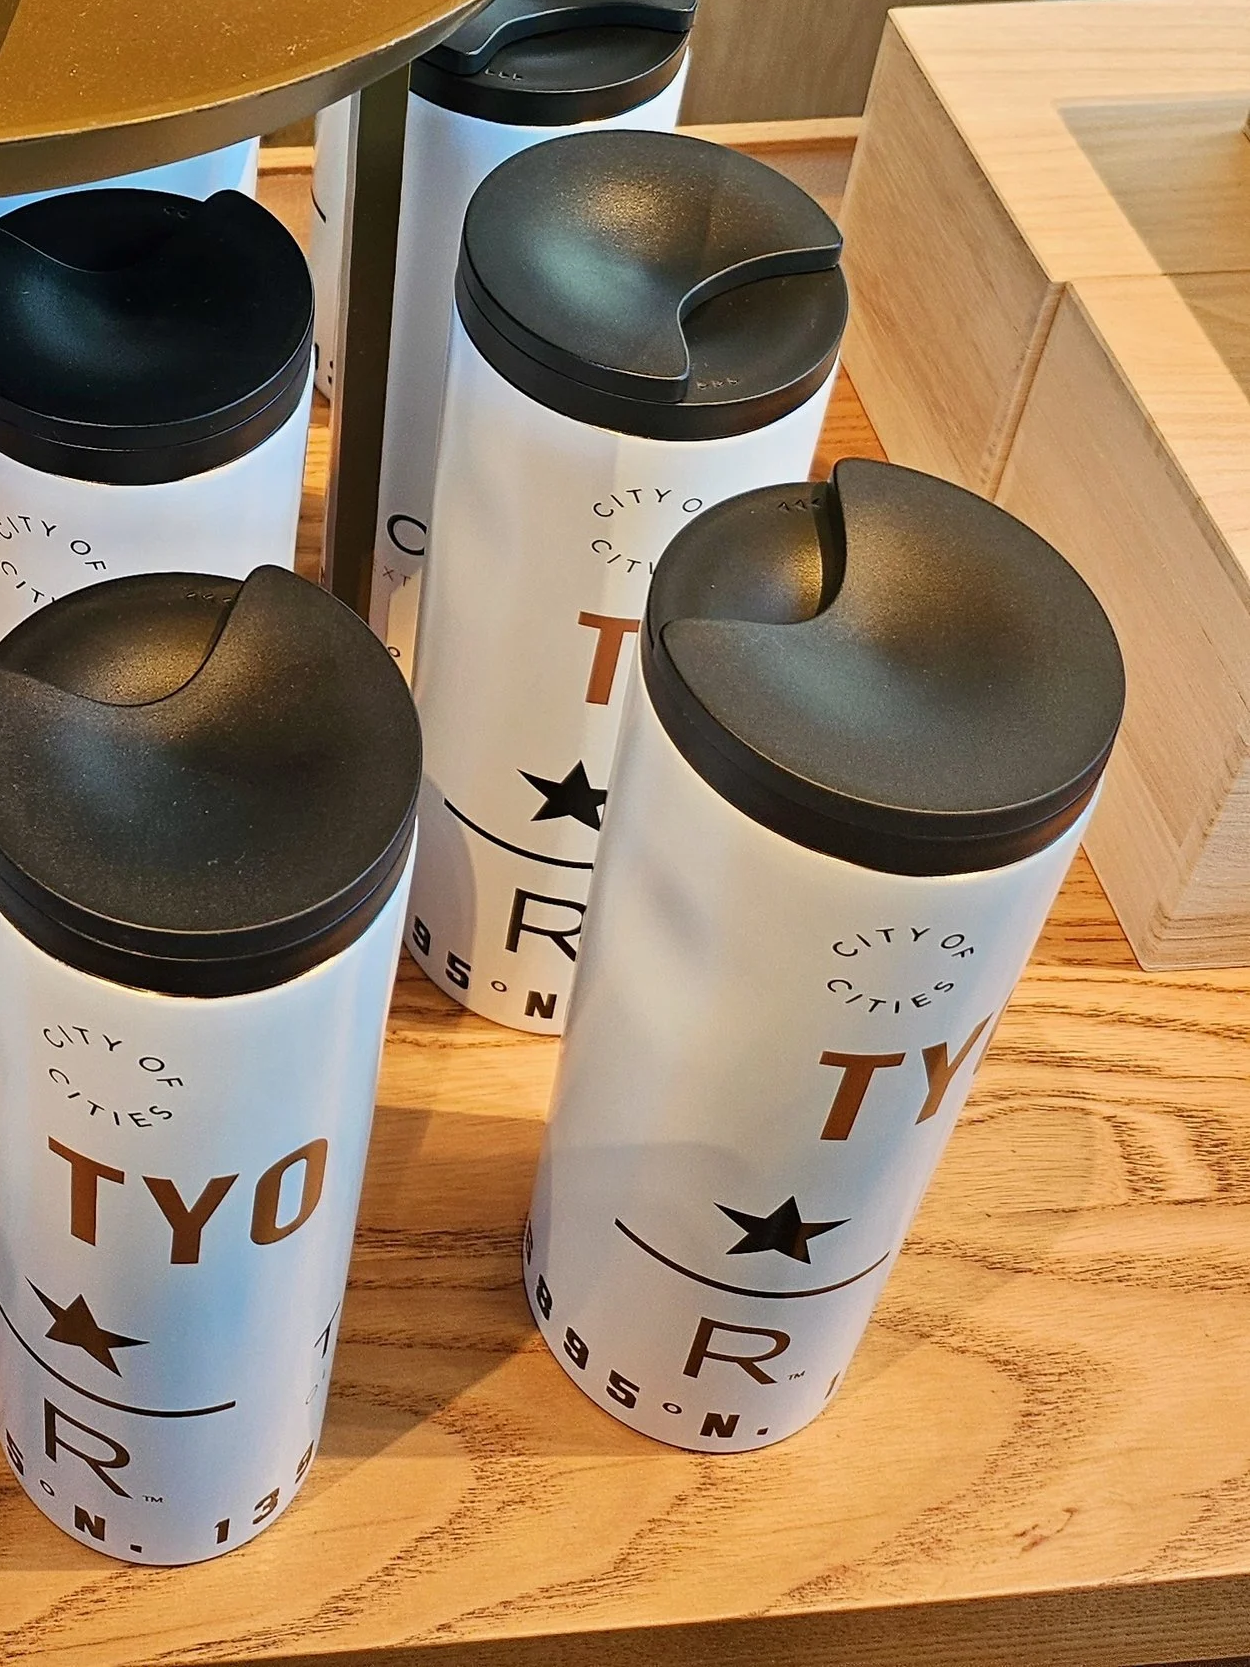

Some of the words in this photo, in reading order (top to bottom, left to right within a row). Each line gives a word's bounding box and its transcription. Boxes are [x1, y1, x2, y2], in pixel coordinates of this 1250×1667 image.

[593, 488, 672, 517] CITY
[70, 540, 107, 570] OF
[831, 925, 931, 958] CITY
[940, 931, 976, 960] OF
[826, 977, 955, 1014] CITIES
[42, 1024, 124, 1053] CITY
[137, 1054, 185, 1090] OF
[819, 990, 1014, 1140] TY
[48, 1066, 174, 1129] CITIES
[47, 1135, 329, 1266] TYO
